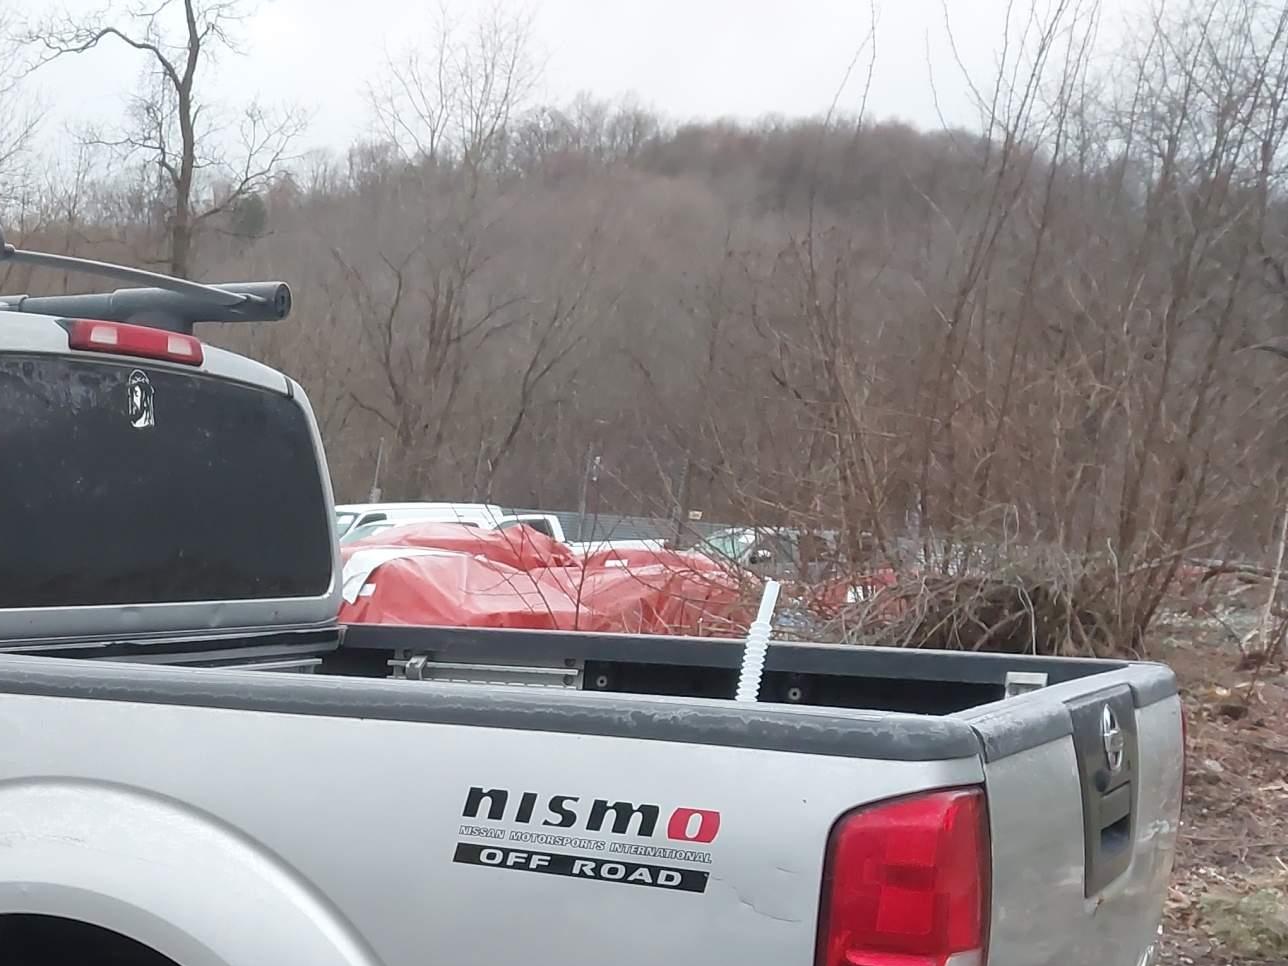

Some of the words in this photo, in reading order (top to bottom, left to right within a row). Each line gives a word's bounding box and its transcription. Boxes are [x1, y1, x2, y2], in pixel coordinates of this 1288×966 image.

[458, 824, 506, 840] NISSAN
[509, 829, 606, 851] MOTORSPORTS
[608, 841, 713, 865] INTERNATIONAL
[478, 847, 552, 869] OFF
[572, 858, 683, 888] ROAD
